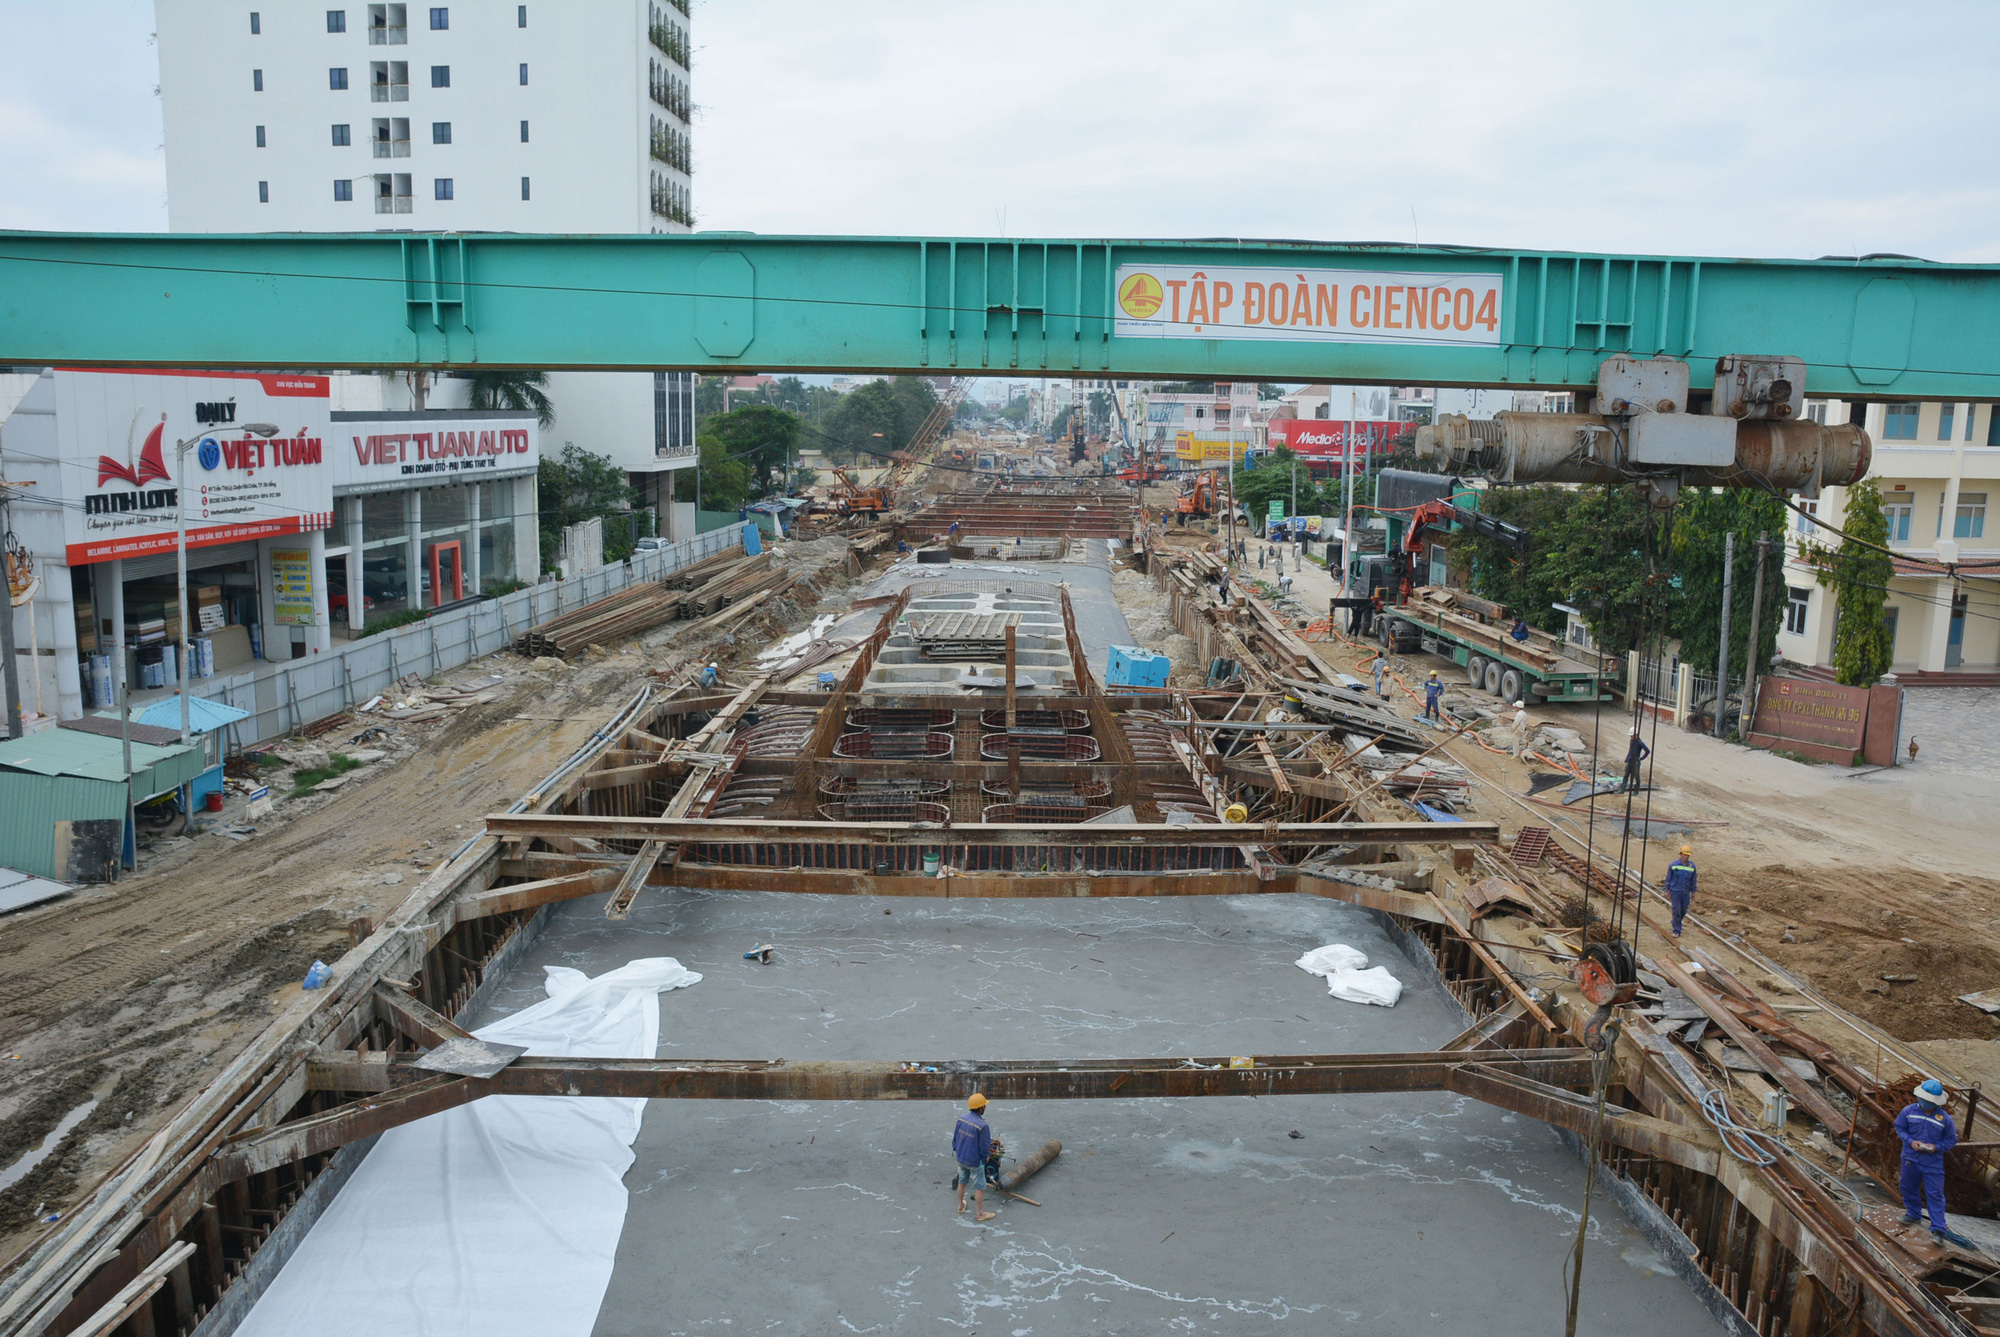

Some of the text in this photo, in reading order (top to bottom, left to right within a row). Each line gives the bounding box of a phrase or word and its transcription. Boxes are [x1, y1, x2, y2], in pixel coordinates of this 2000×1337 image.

[1166, 272, 1498, 332] TẬP ĐOÀN CIENCO4
[221, 427, 322, 476] VIỆT TUẤN
[353, 429, 528, 466] VIET TUAN AUTO
[1784, 700, 1792, 712] TY
